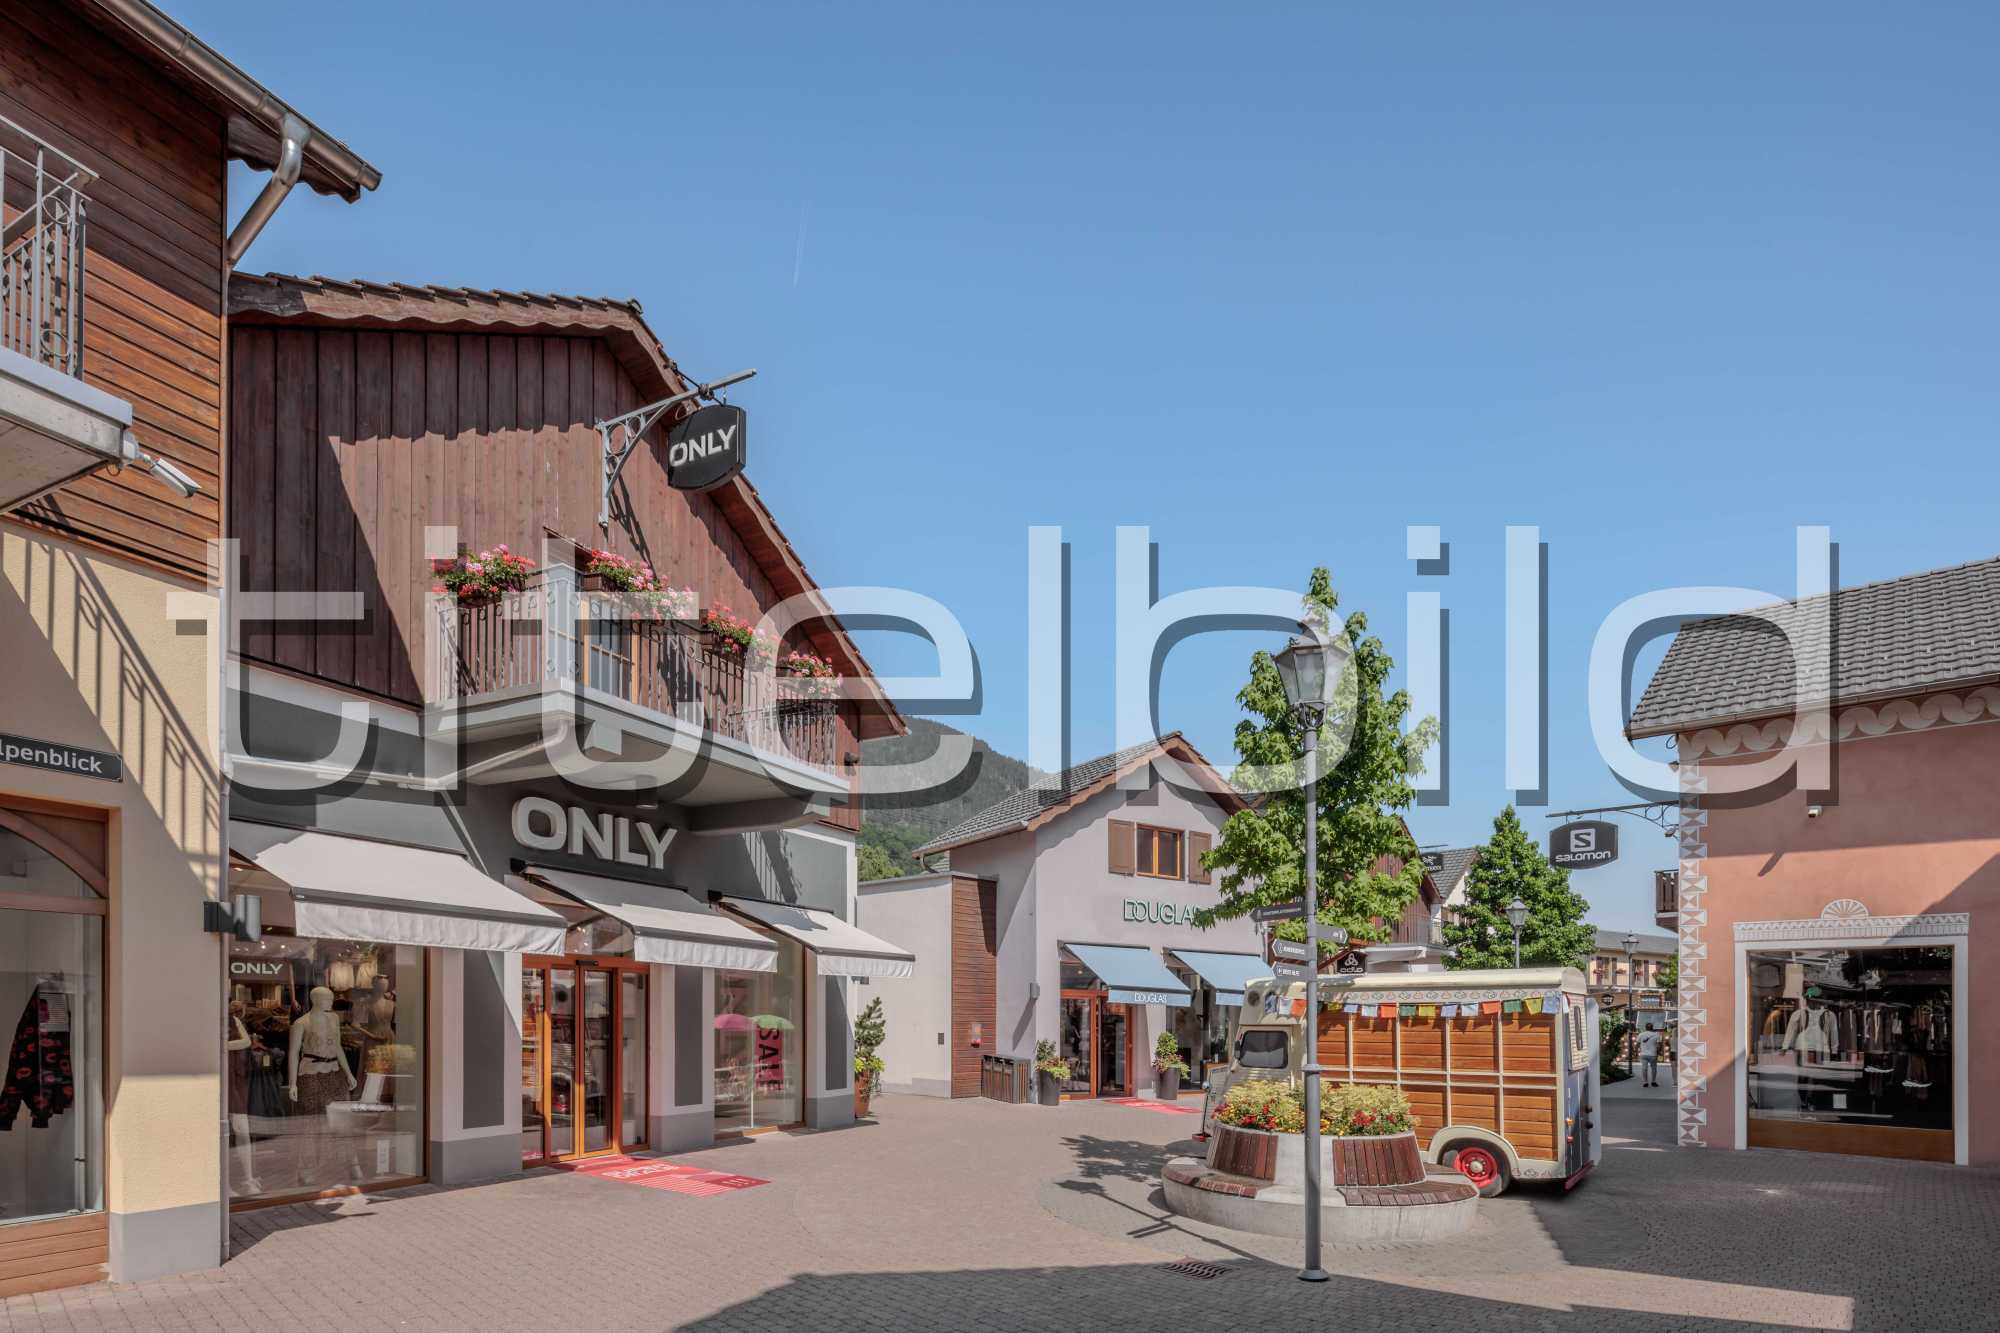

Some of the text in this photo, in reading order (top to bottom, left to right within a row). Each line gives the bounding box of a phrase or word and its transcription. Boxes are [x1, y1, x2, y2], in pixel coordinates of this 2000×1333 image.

[669, 424, 737, 467] ONLY
[511, 796, 678, 870] ONLY
[230, 962, 283, 975] ONLY
[1134, 992, 1168, 1003] DOUGLAS
